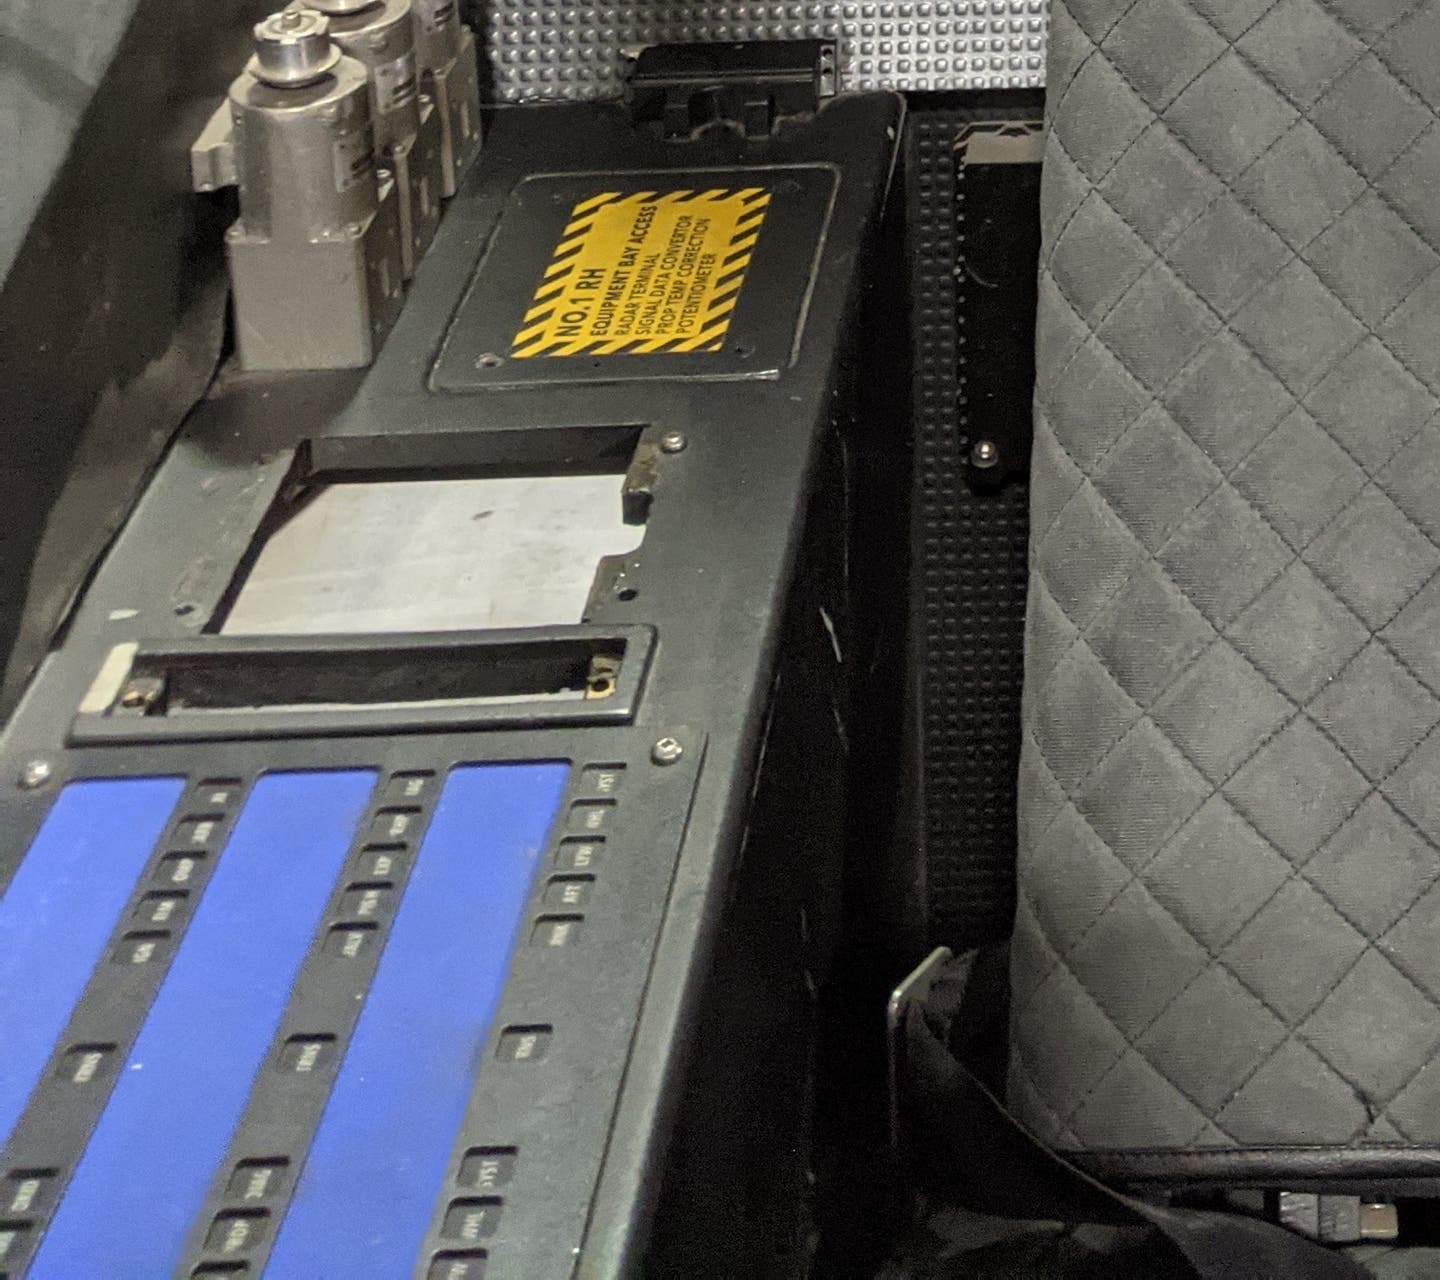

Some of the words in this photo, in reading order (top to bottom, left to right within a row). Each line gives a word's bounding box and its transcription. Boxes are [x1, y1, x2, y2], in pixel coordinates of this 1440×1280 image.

[630, 205, 658, 243] ACCESS
[659, 215, 693, 270] CONVERTOR
[620, 247, 641, 267] BAY
[676, 218, 711, 277] CORRECTION
[556, 298, 593, 337] NO.1
[576, 269, 606, 289] RH
[590, 270, 630, 337] EQUIPMENT
[614, 303, 640, 336] RADAR
[628, 253, 660, 299] TERMINAL
[648, 271, 671, 297] DATA
[666, 279, 687, 303] TEMP
[676, 253, 717, 333] POTENTIOMETER
[635, 298, 662, 334] SIGNAL
[656, 307, 678, 334] PROP
